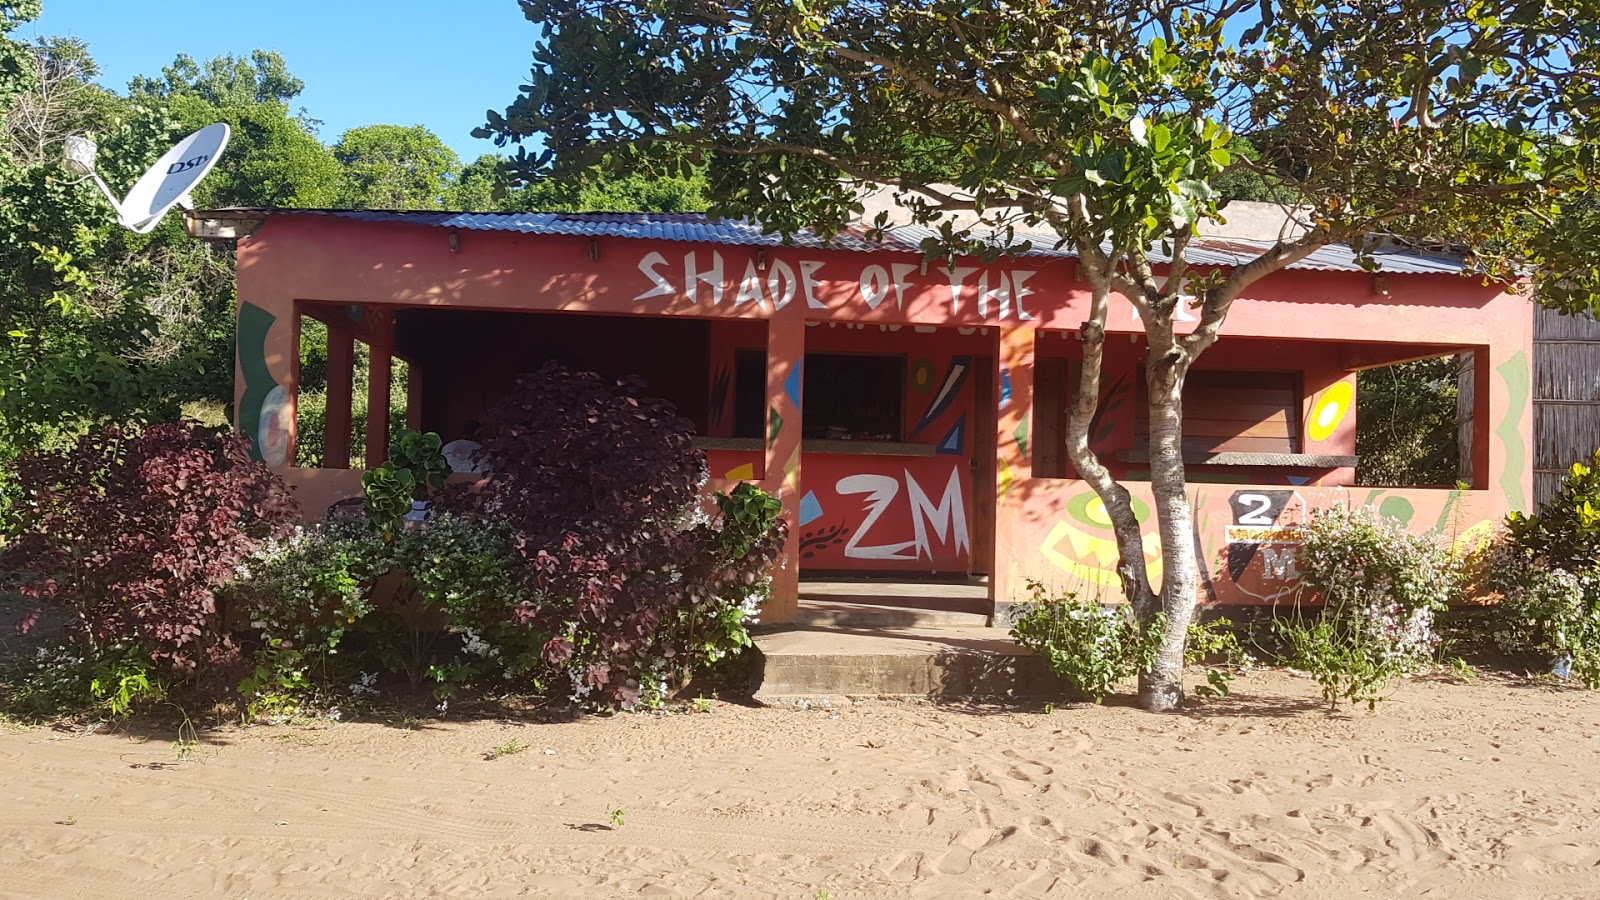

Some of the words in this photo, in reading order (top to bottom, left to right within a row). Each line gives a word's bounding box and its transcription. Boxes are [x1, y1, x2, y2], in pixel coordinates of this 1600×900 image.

[632, 249, 829, 312] SHADE
[859, 263, 919, 312] OF
[936, 266, 1038, 321] THE
[1237, 493, 1272, 525] 2
[1262, 547, 1300, 581] M
